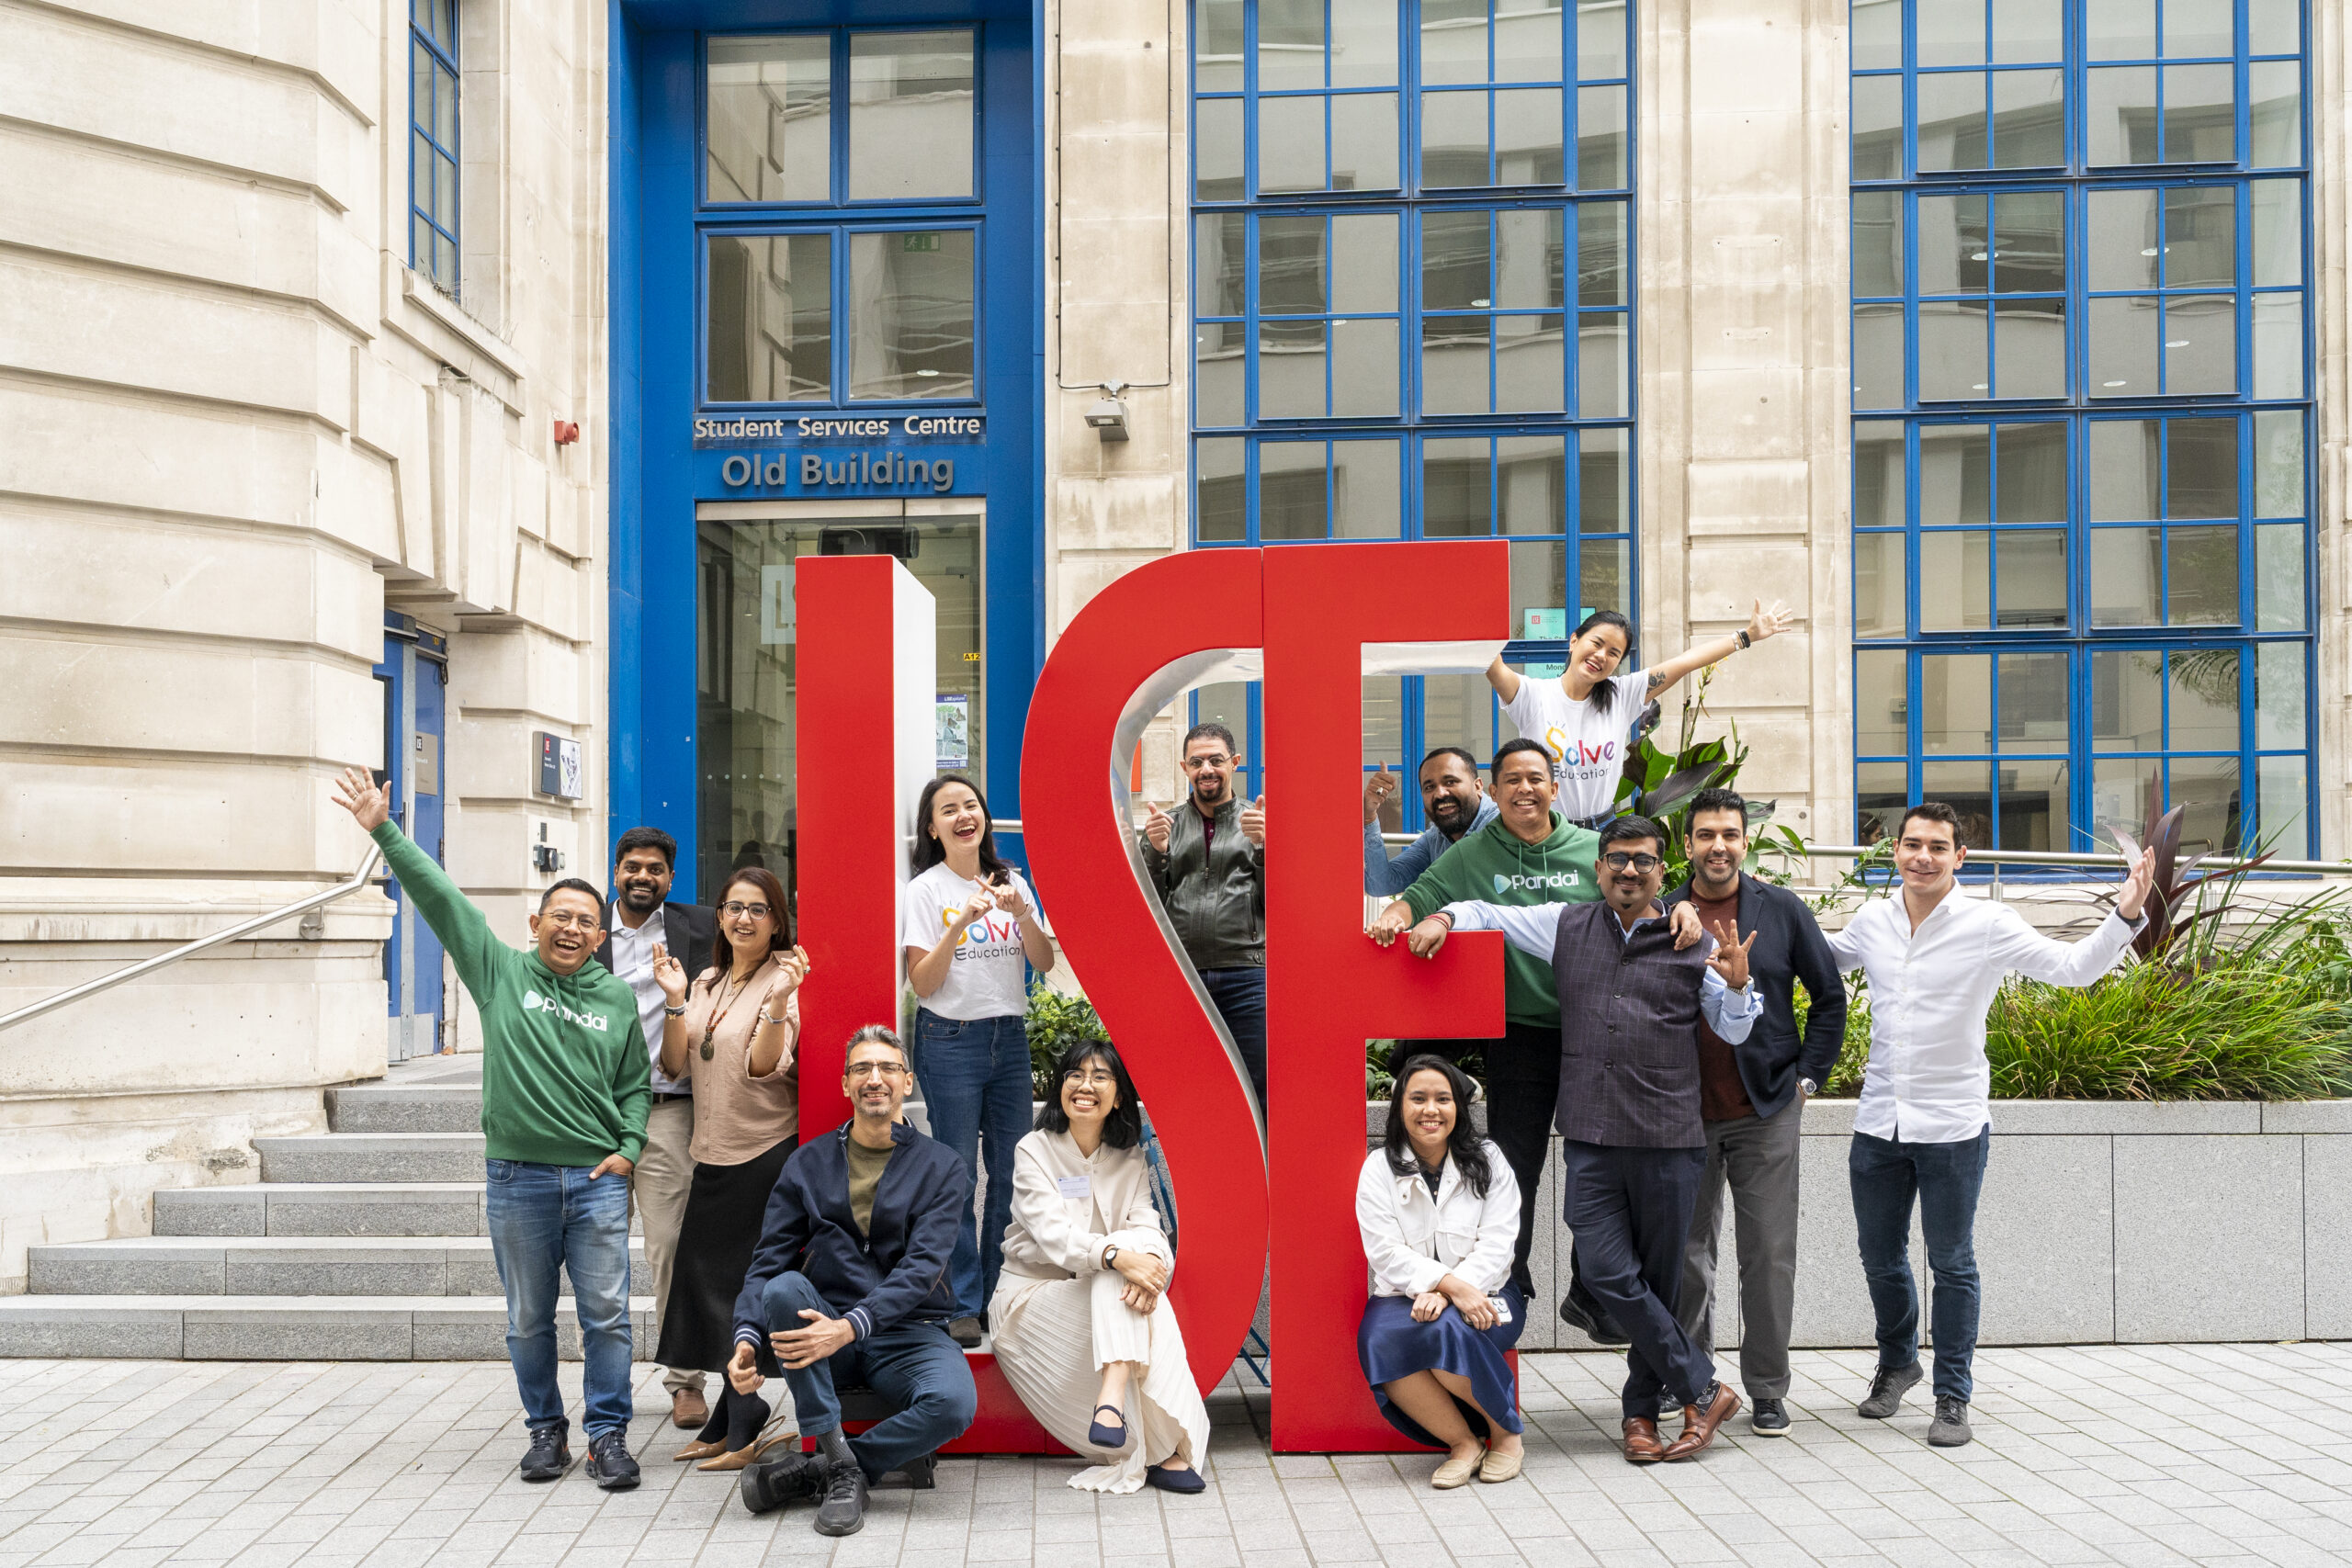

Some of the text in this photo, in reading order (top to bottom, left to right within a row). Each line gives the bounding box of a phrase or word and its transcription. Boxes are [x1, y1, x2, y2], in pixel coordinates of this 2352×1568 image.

[695, 415, 980, 438] Student Services Centre
[722, 451, 954, 491] Old Building
[1546, 726, 1614, 766] Solve
[1511, 869, 1578, 890] Pandai
[955, 945, 1021, 961] Education
[542, 997, 607, 1032] Pandai
